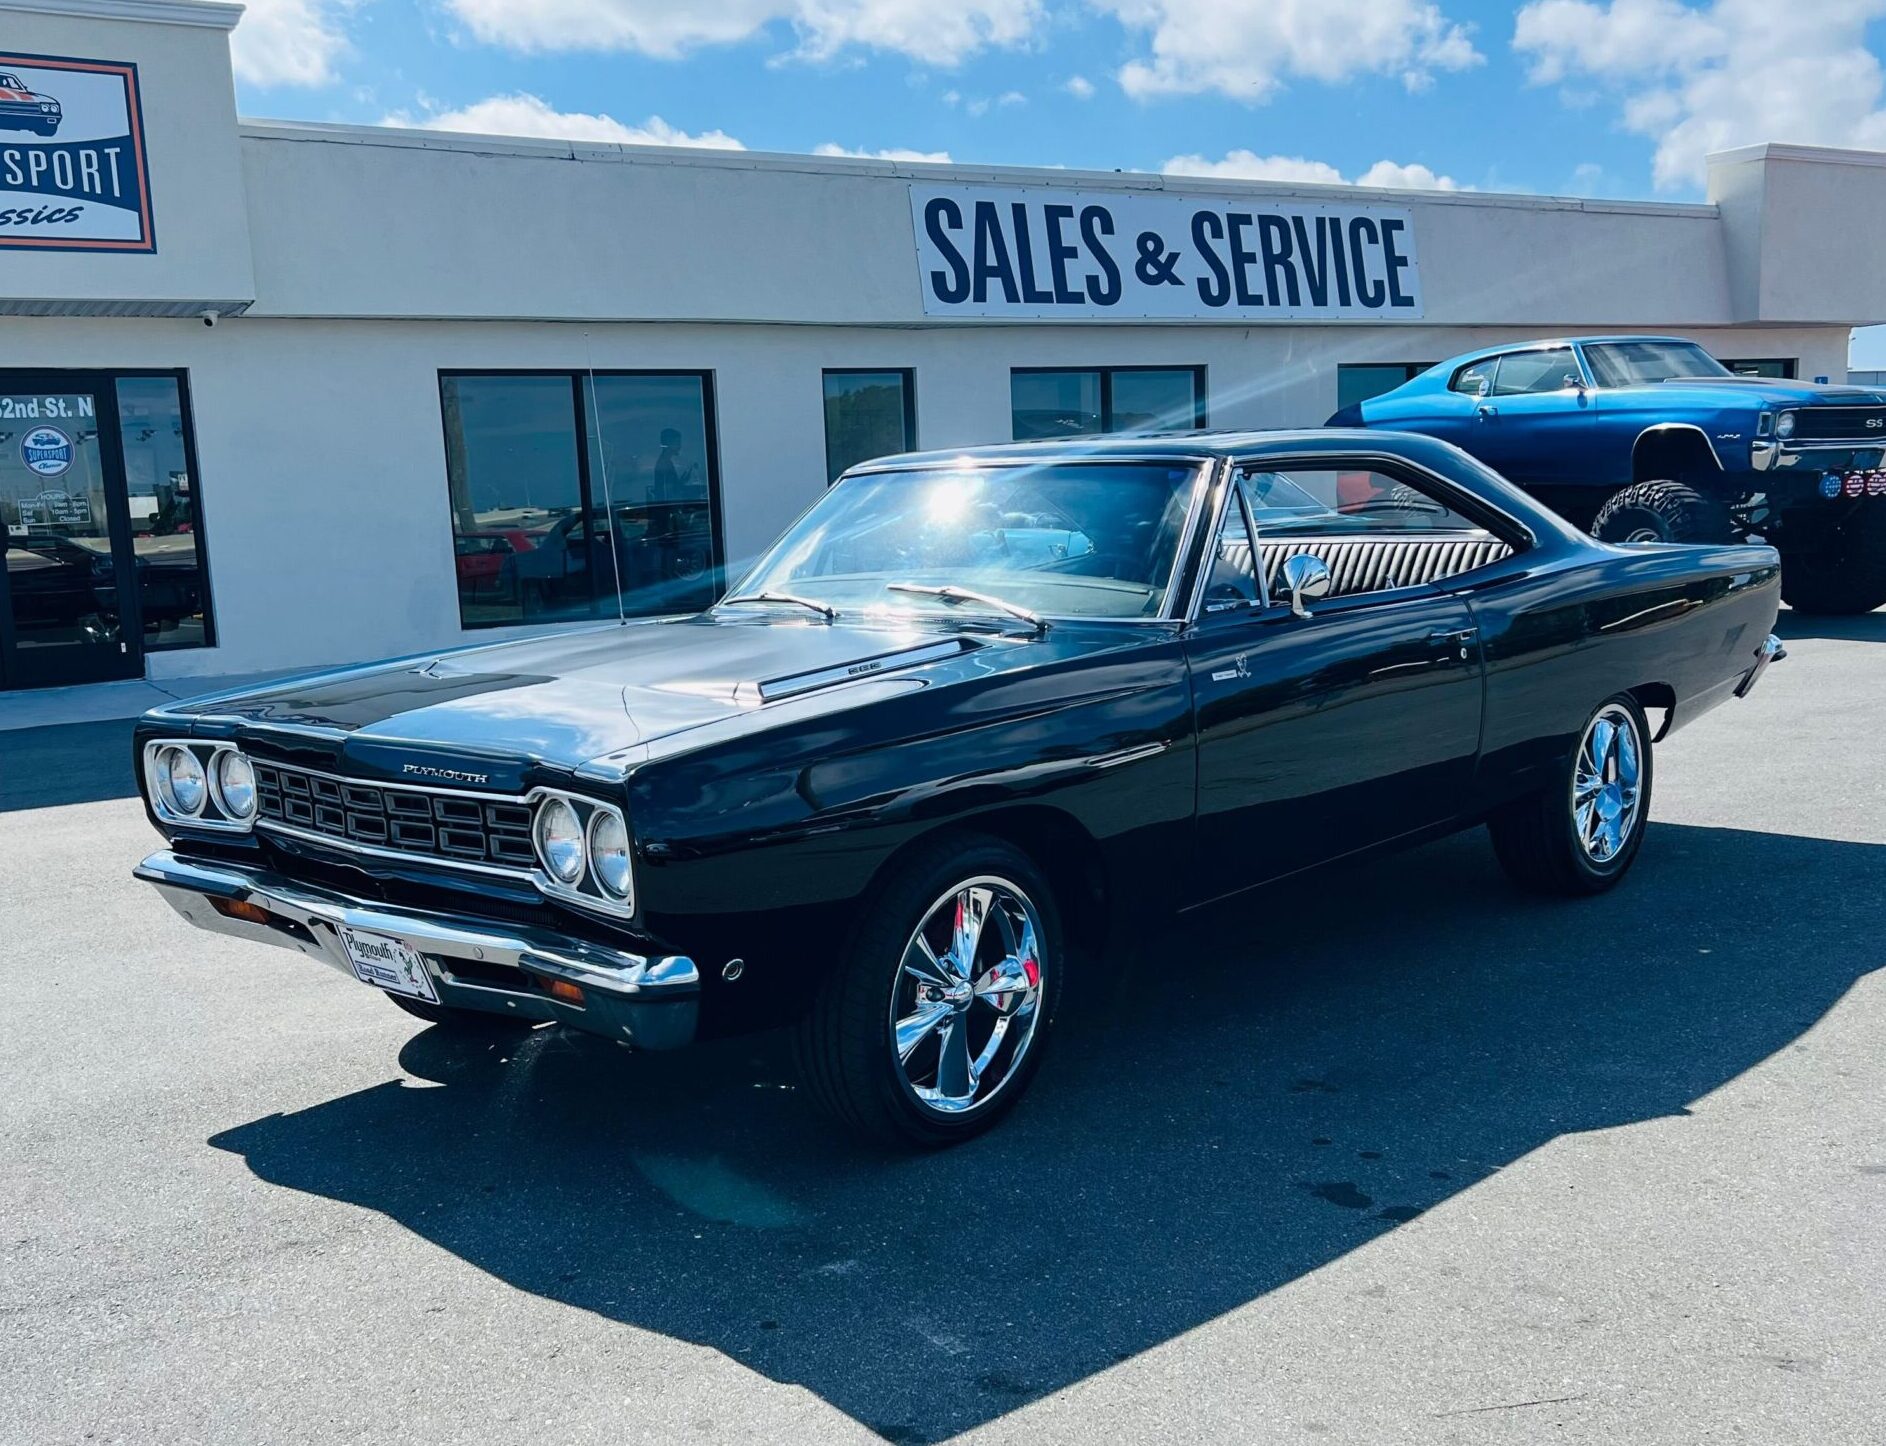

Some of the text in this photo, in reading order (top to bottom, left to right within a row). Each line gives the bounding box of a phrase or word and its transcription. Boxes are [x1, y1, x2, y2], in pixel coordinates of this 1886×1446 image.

[3, 147, 120, 198] SPORT
[924, 197, 1416, 309] SALES & SERVICE
[0, 396, 93, 418] 2nd St. N
[1865, 418, 1883, 428] SS
[28, 448, 67, 461] SUPERSPORT
[403, 764, 488, 783] PLYMOUTH
[343, 931, 394, 961] Plymouth
